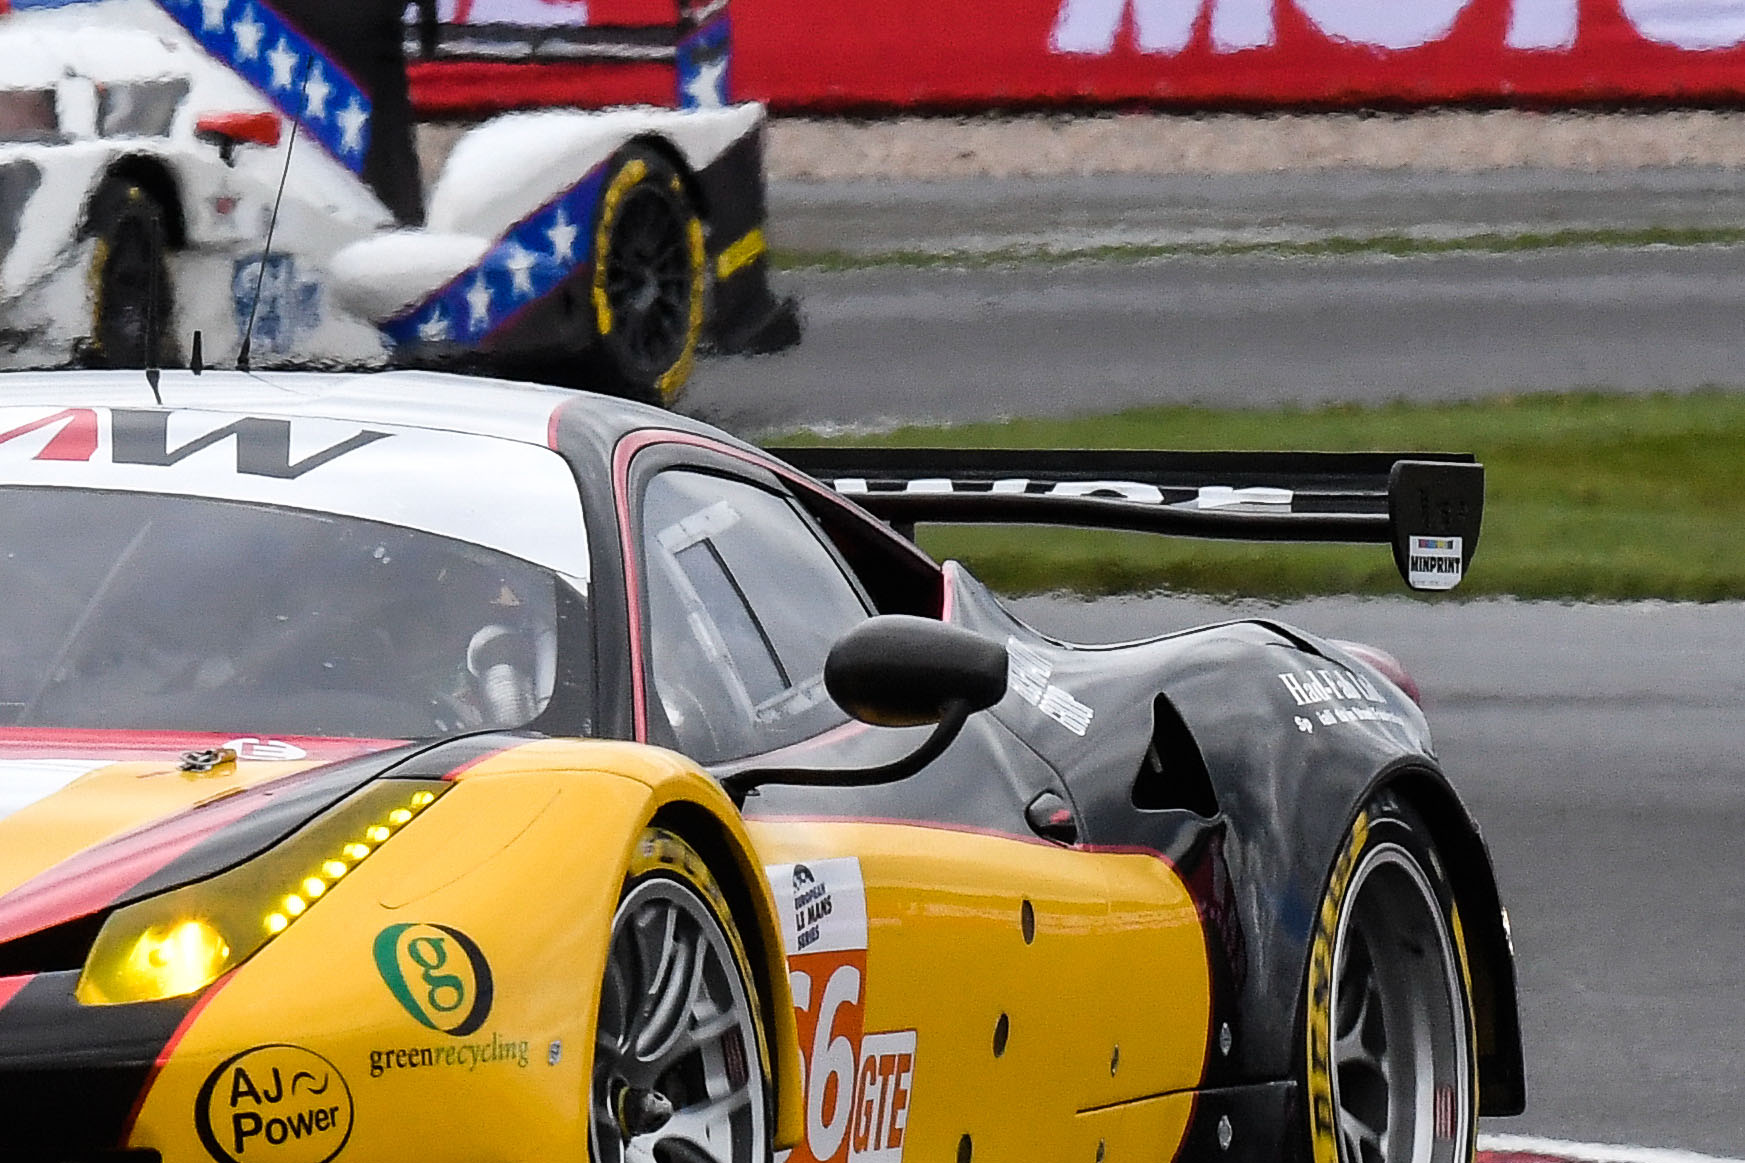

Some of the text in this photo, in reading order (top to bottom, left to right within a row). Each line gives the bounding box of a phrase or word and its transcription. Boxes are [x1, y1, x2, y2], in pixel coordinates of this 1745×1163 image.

[1410, 555, 1461, 574] MINPRINT
[807, 895, 833, 926] MANS
[230, 1067, 283, 1108] AJ
[853, 1053, 912, 1154] GTE
[232, 1105, 339, 1154] Power
